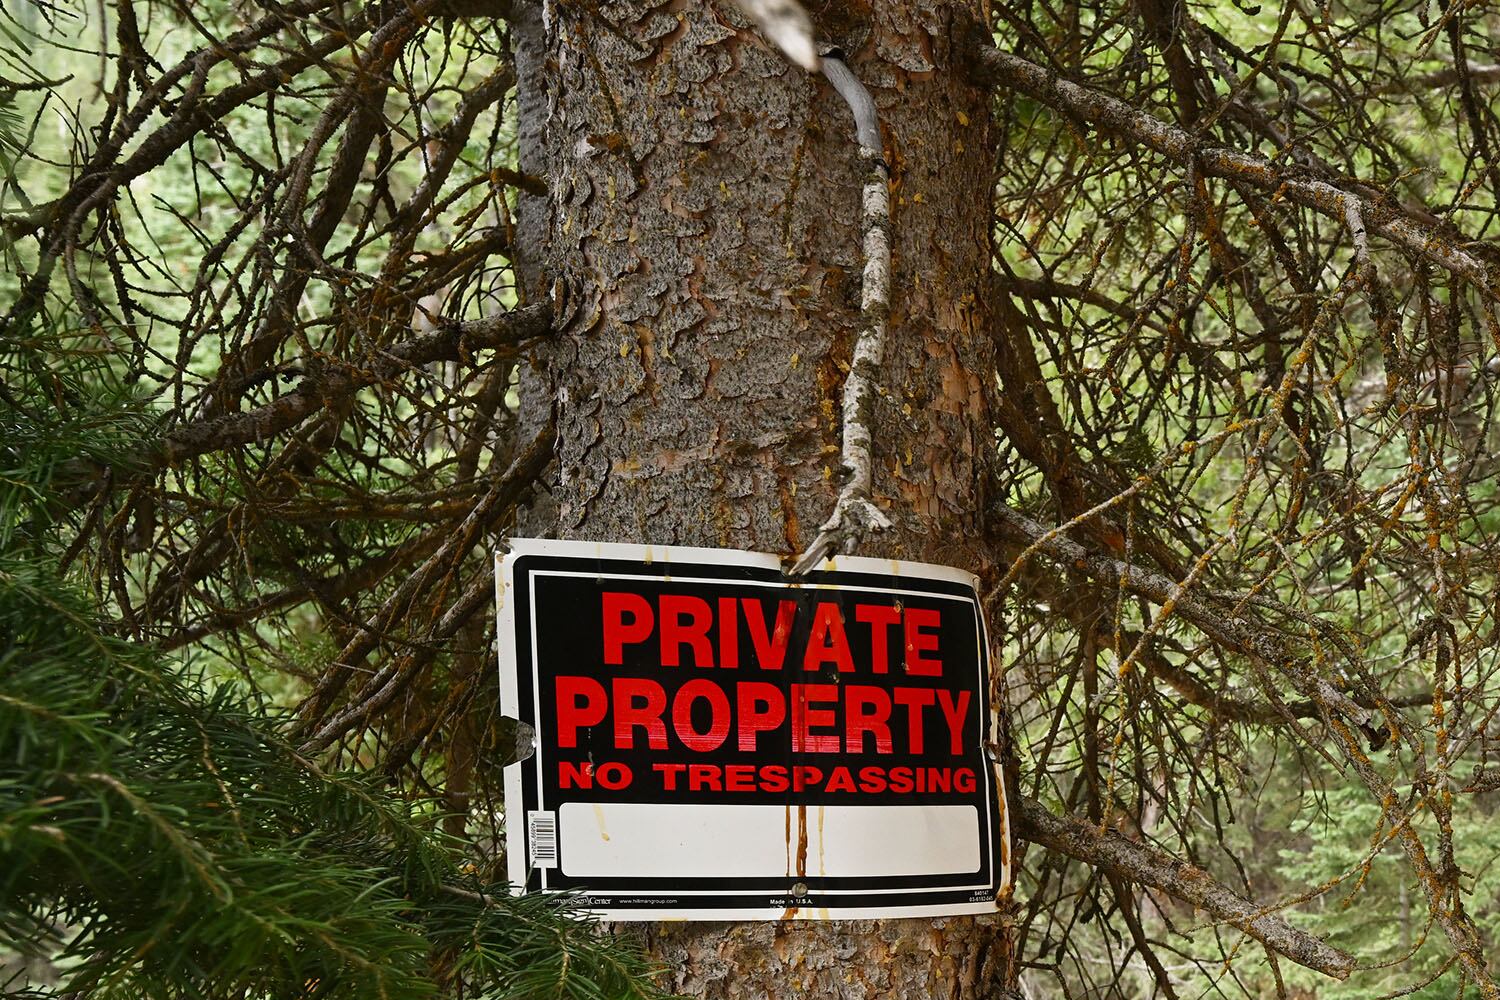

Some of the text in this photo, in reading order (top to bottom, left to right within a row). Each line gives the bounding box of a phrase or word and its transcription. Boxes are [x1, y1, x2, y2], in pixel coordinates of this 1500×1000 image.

[603, 592, 943, 677] PRIVATE
[556, 676, 971, 755] PROPERTY
[559, 761, 977, 793] NO TRESPASSING
[589, 897, 612, 905] Center
